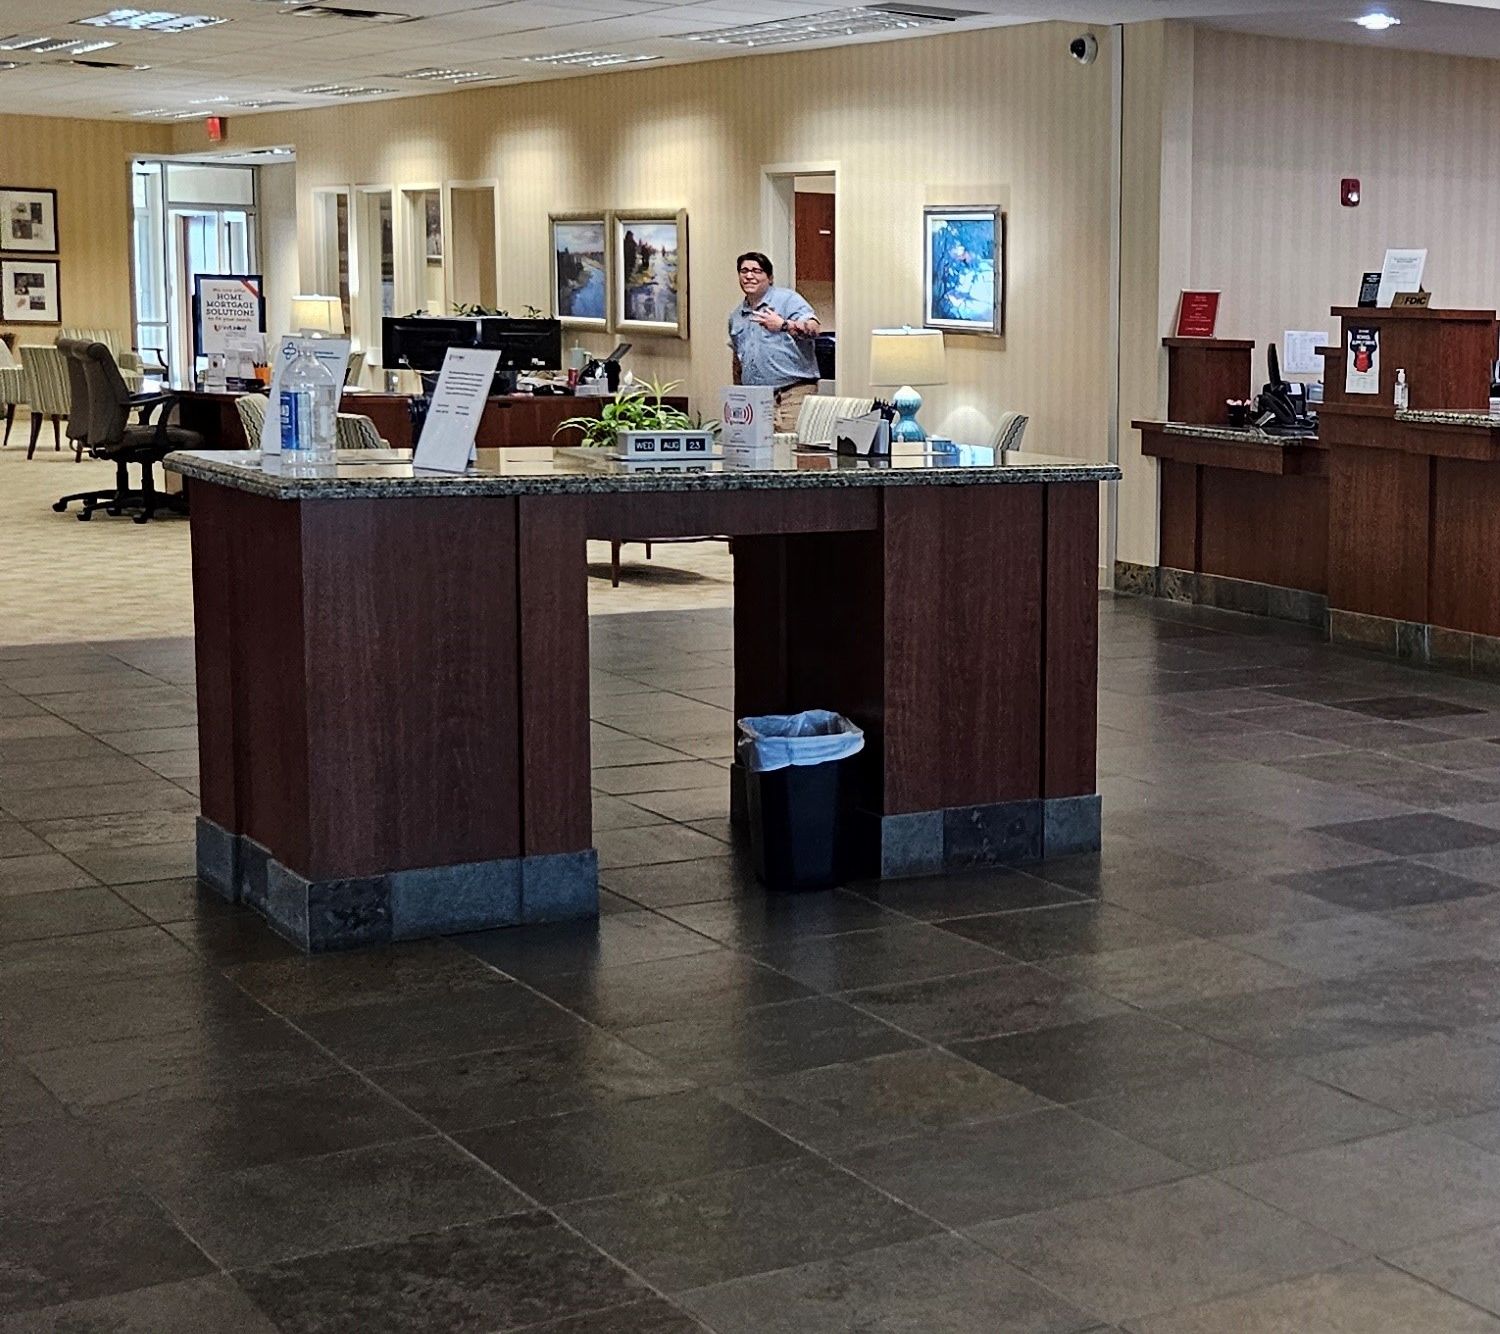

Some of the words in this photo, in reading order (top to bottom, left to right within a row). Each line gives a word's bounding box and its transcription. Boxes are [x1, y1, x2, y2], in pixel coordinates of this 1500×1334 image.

[206, 300, 254, 308] MORTGAGE
[1404, 297, 1427, 305] FDIC
[636, 441, 654, 450] WED
[663, 441, 679, 450] AUG
[689, 441, 701, 450] 23
